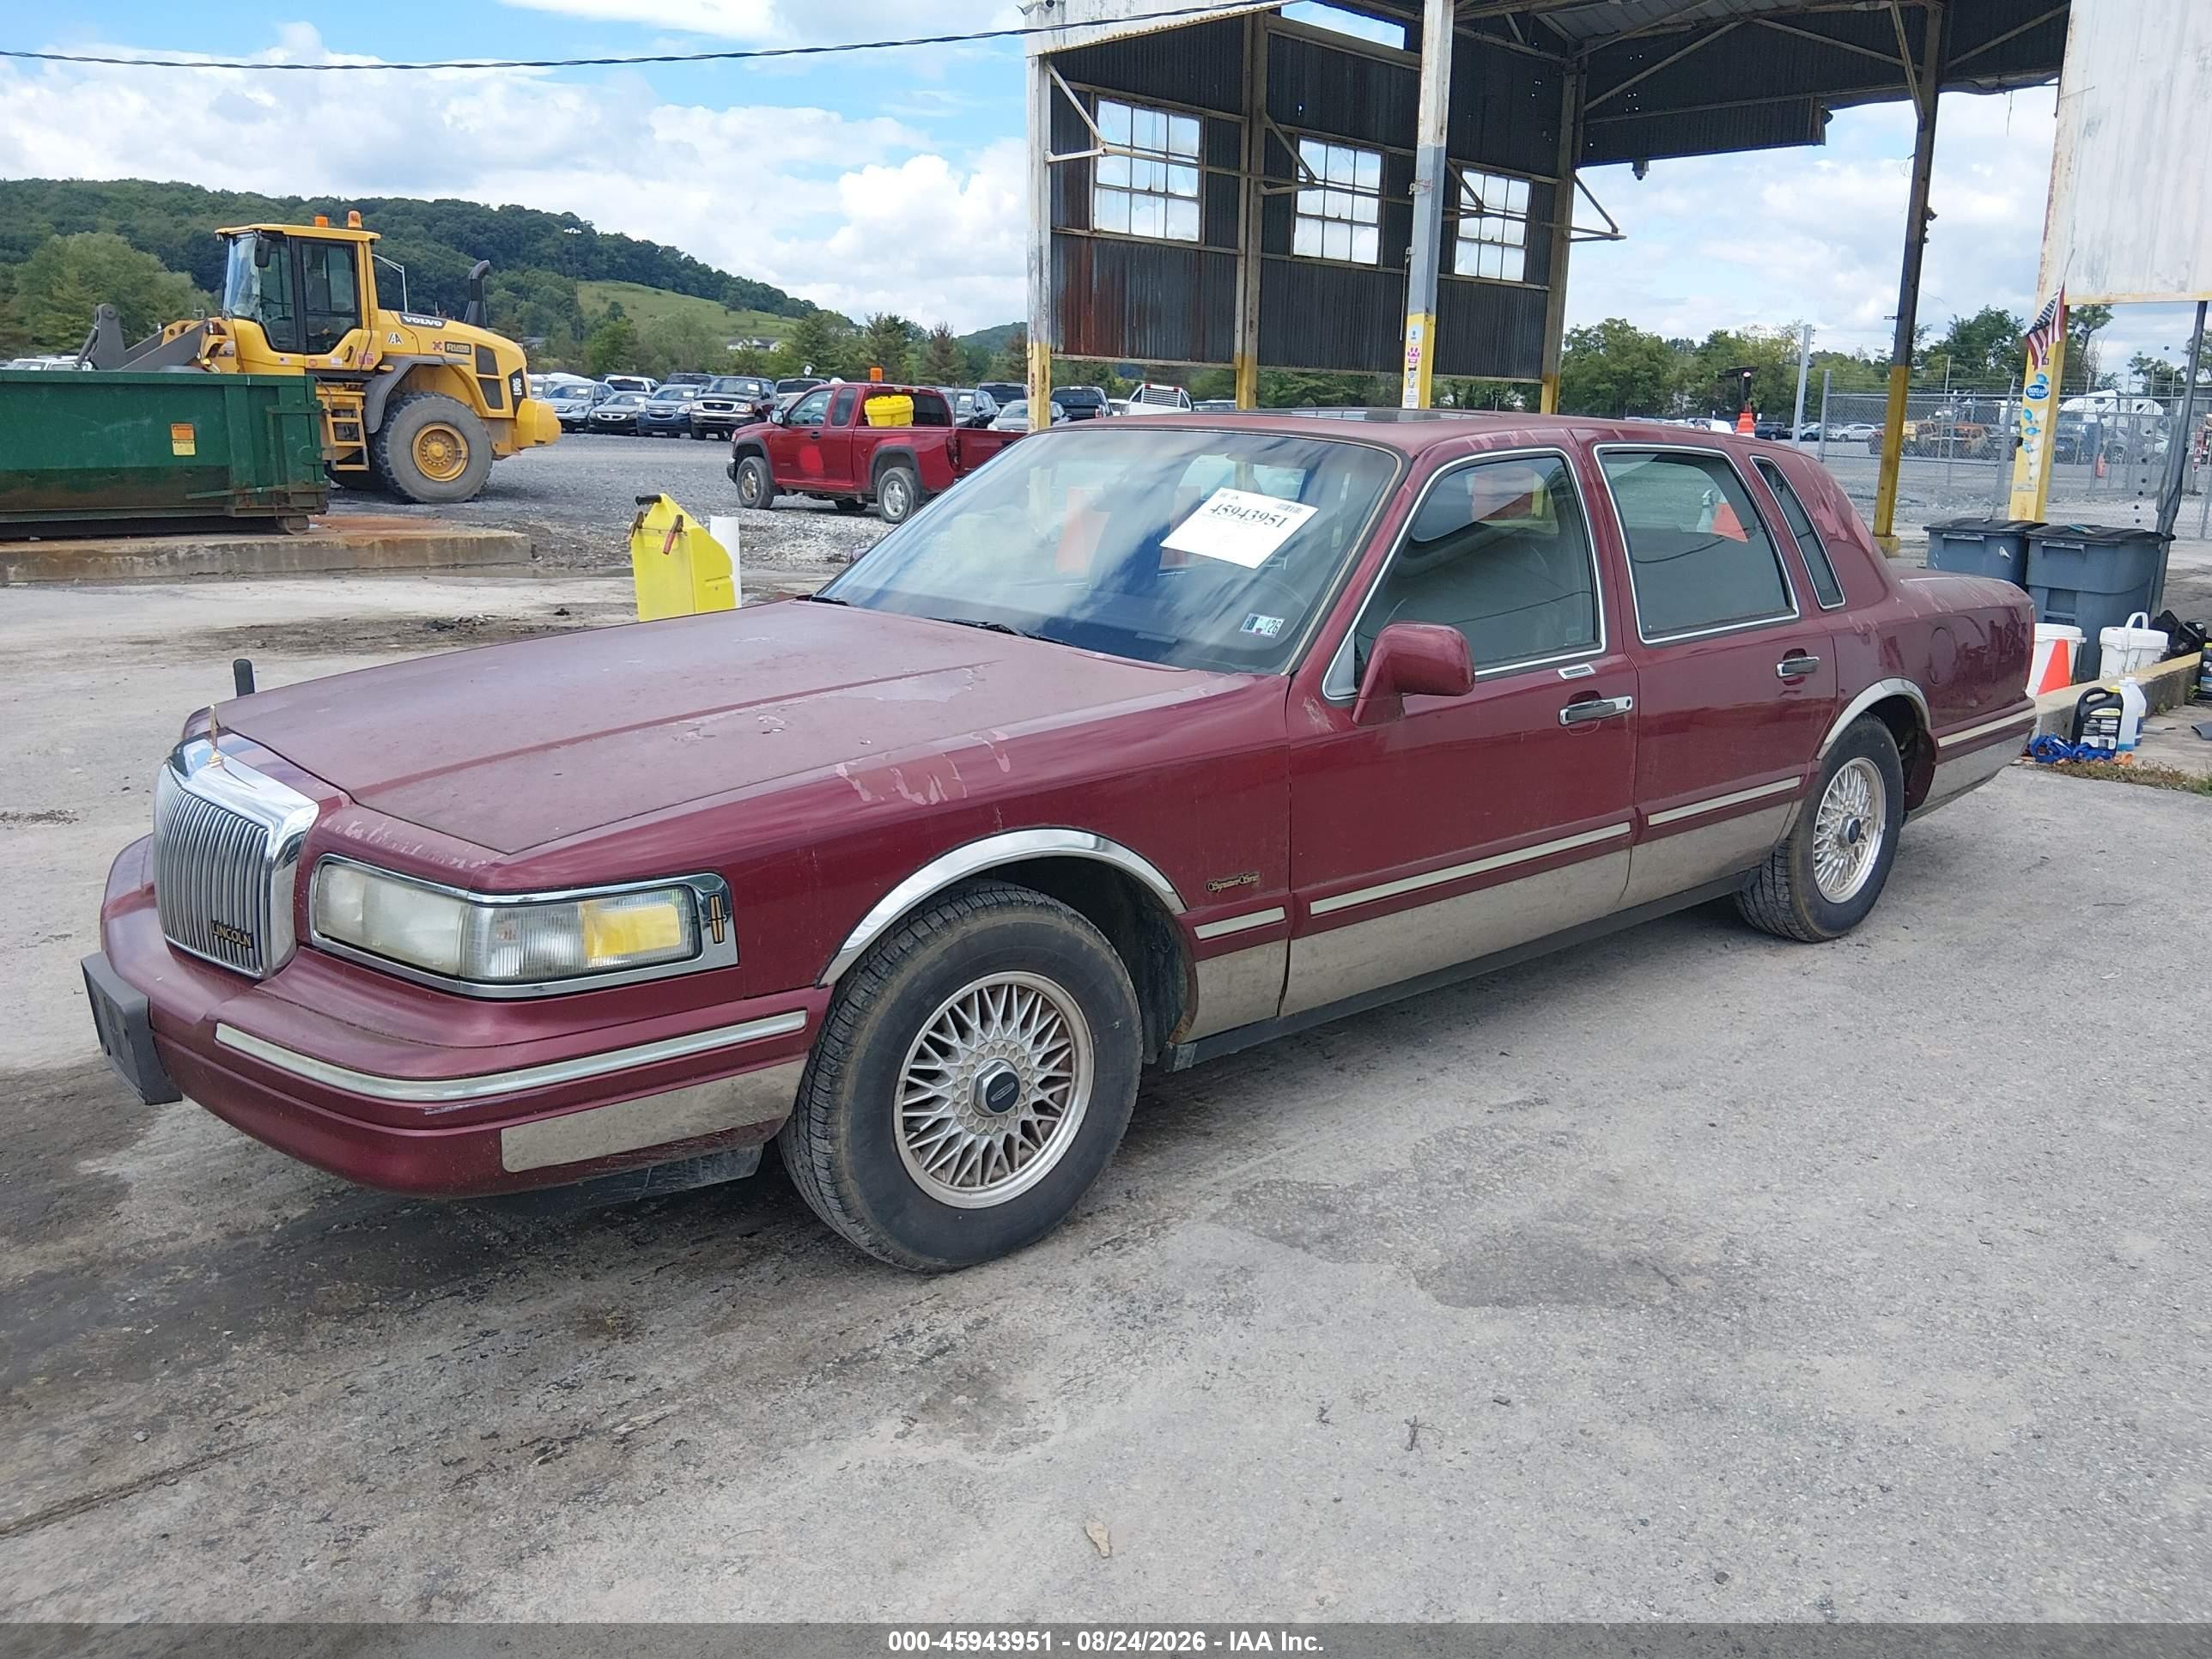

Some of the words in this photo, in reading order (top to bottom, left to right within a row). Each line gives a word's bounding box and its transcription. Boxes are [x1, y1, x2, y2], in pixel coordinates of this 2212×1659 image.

[403, 315, 443, 327] VOLVO
[1210, 503, 1289, 528] 45943951
[212, 922, 252, 947] LINCOLN
